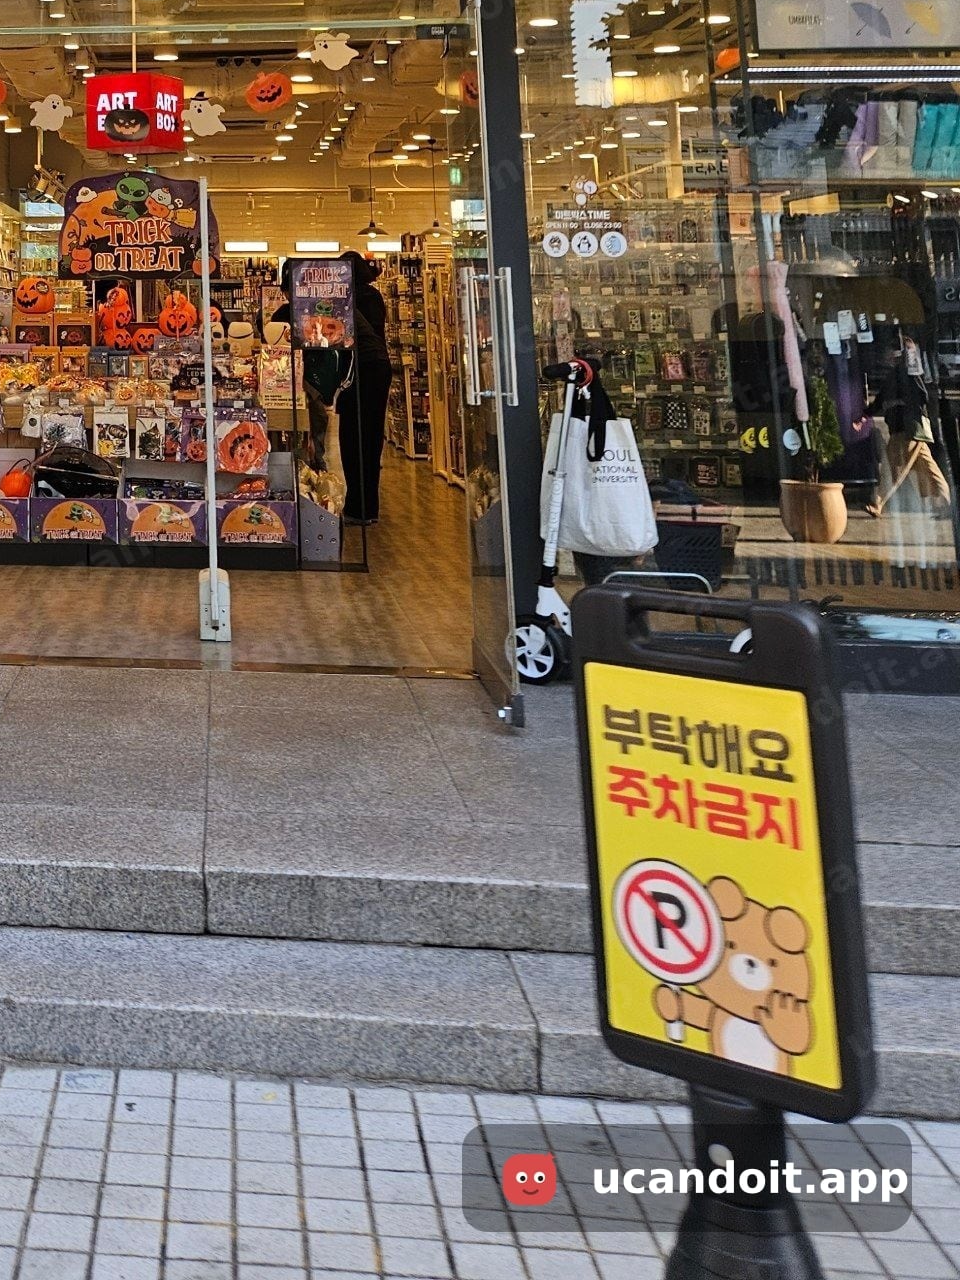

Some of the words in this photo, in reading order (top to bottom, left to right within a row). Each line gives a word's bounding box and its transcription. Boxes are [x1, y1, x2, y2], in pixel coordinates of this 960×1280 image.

[97, 92, 137, 111] ART
[156, 92, 178, 112] ART
[104, 220, 173, 246] TRICK
[95, 252, 114, 271] OR
[114, 246, 184, 271] TREAT
[301, 267, 343, 282] TRICK
[309, 283, 350, 298] TREAT
[604, 704, 794, 783] 부탁해요
[608, 765, 803, 850] 주차금지
